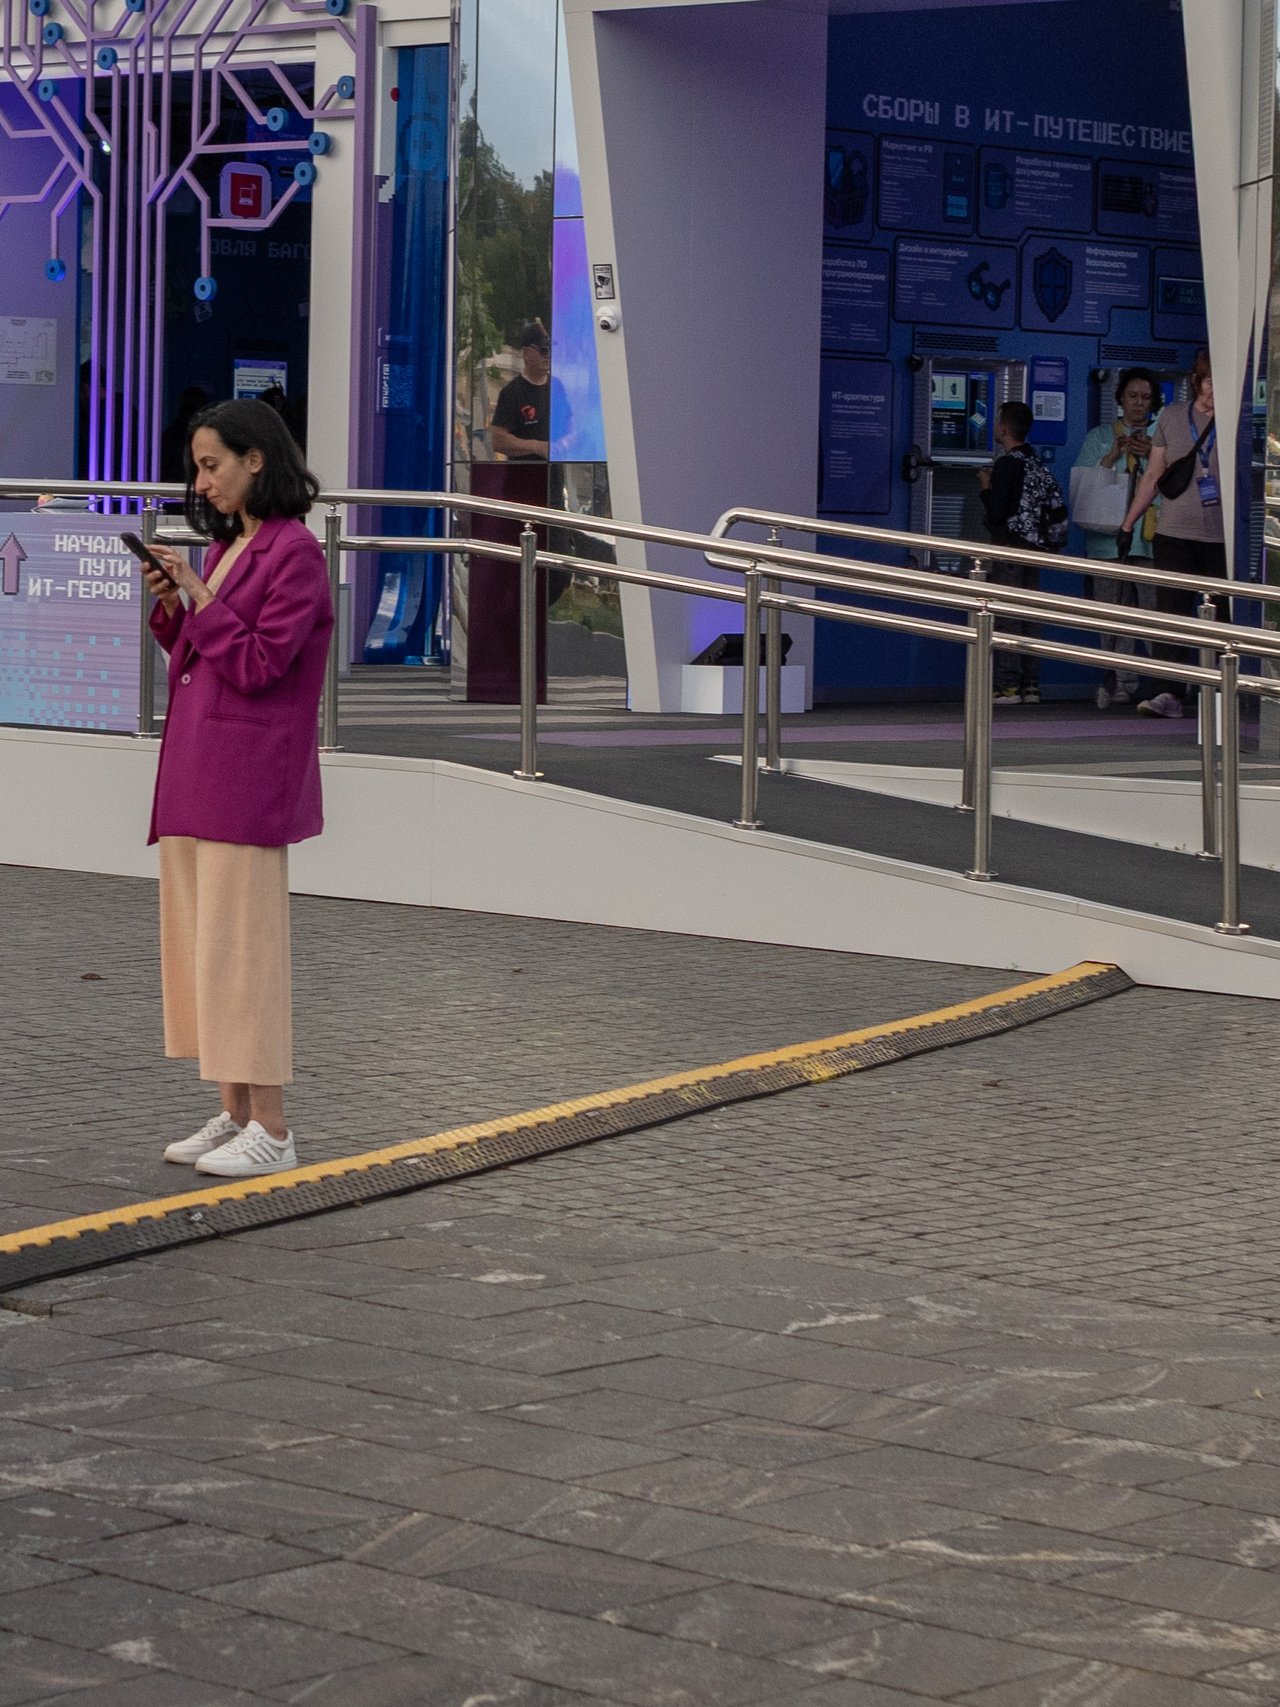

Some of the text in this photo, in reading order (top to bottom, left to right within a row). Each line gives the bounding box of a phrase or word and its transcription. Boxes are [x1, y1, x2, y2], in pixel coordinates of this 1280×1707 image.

[862, 93, 1192, 155] СБОРЫ В ИТ-ПУТЕШЕСТВИЕ
[196, 238, 257, 256] ОВЛЯ
[79, 558, 131, 577] ПУТИ
[28, 578, 131, 600] ИТ-ГЕРОЯ
